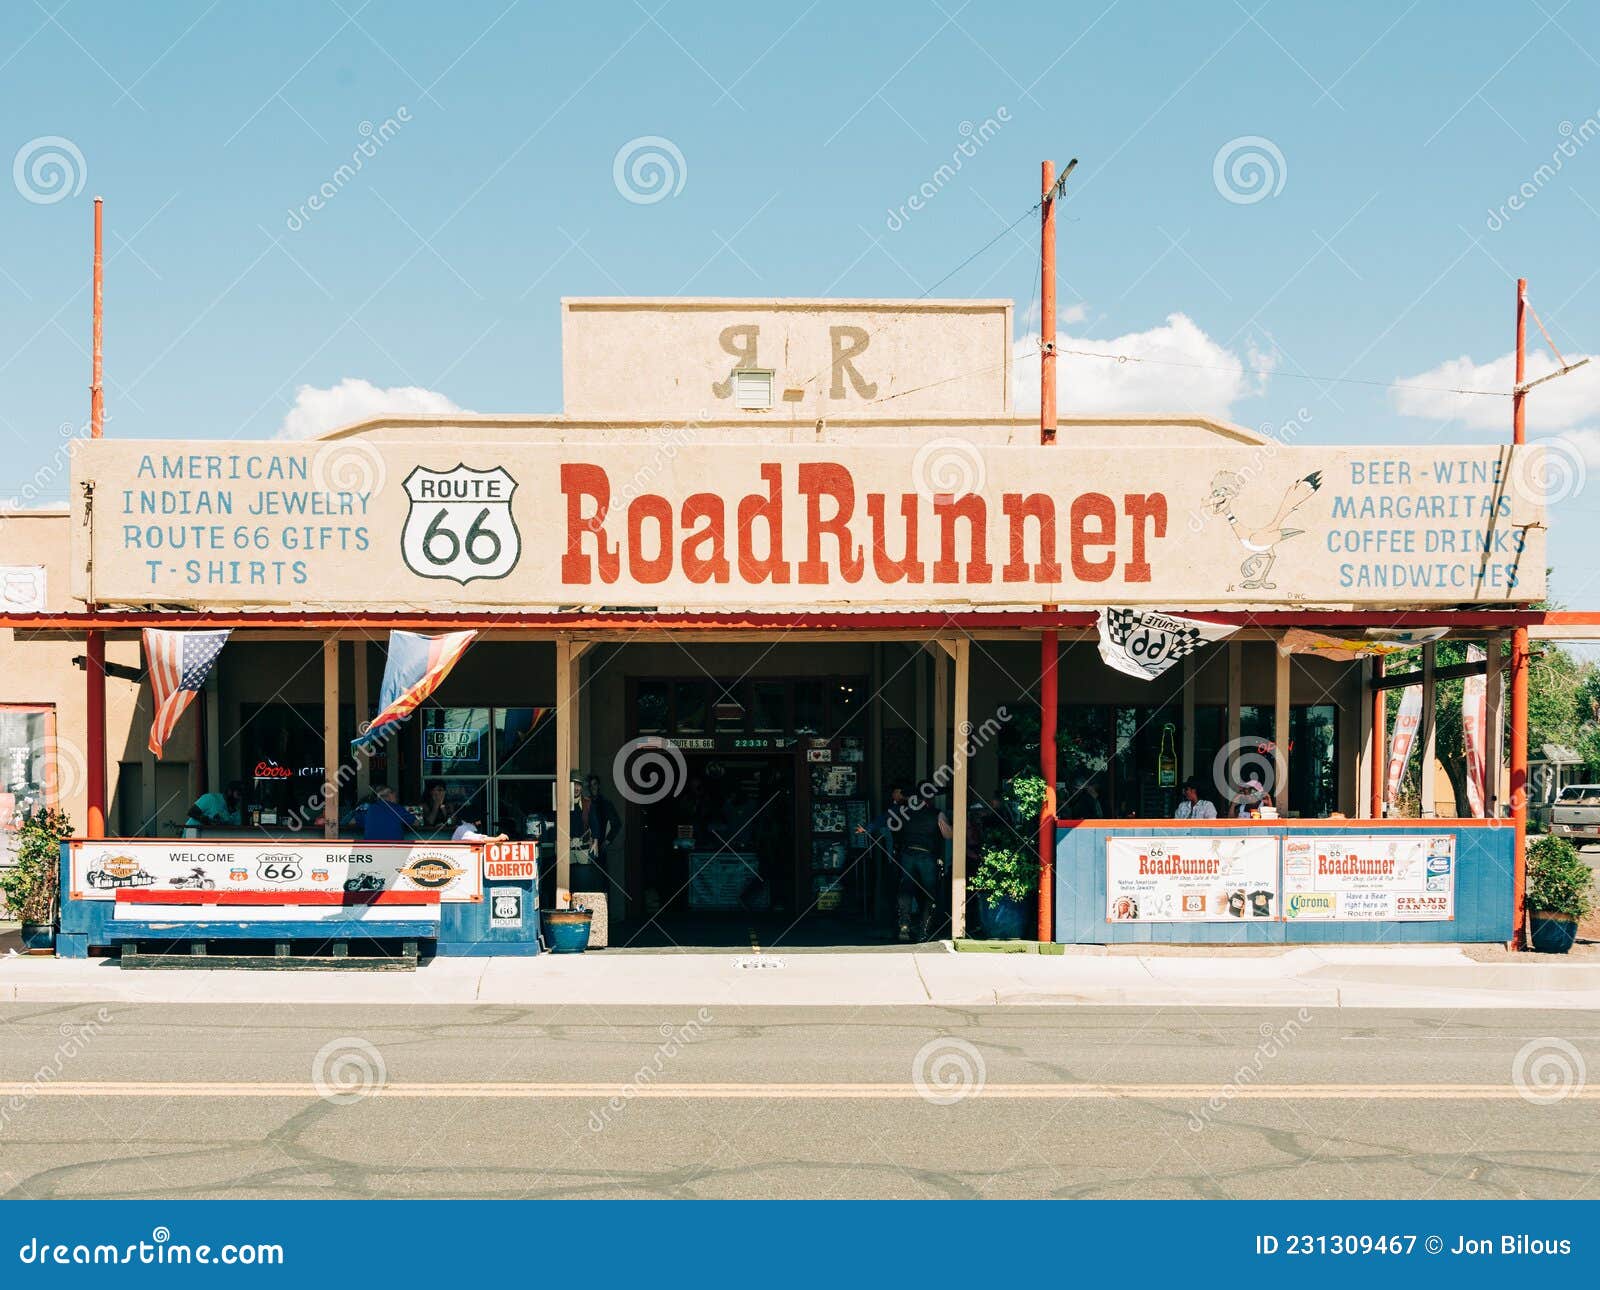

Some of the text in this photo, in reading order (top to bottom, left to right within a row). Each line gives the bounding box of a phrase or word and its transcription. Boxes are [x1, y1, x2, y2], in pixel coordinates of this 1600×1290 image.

[829, 326, 877, 399] R
[137, 455, 308, 480] AMERICAN
[420, 479, 503, 499] ROUTE
[122, 490, 372, 516] INDIAN JEWELRY
[1332, 495, 1512, 519] MARGARITAS
[560, 462, 1168, 585] RoadRunner
[124, 525, 370, 552] ROUTE 66 GIFTS
[421, 507, 503, 567] 66
[1327, 529, 1527, 554] COFFEE DRINKS
[1338, 563, 1520, 589] SANDWICHES
[434, 731, 471, 744] BUD
[735, 739, 769, 747] 22330
[254, 761, 293, 778] Coors
[169, 853, 373, 863] WELCOME BIKERS
[490, 845, 530, 861] OPEN
[1150, 847, 1164, 857] 66
[264, 864, 296, 879] 66
[488, 863, 533, 877] ABIERTO
[1139, 855, 1220, 875] RoadRunner
[1318, 855, 1395, 875] RoadRunner
[1290, 895, 1330, 910] Corona
[1344, 901, 1361, 909] right
